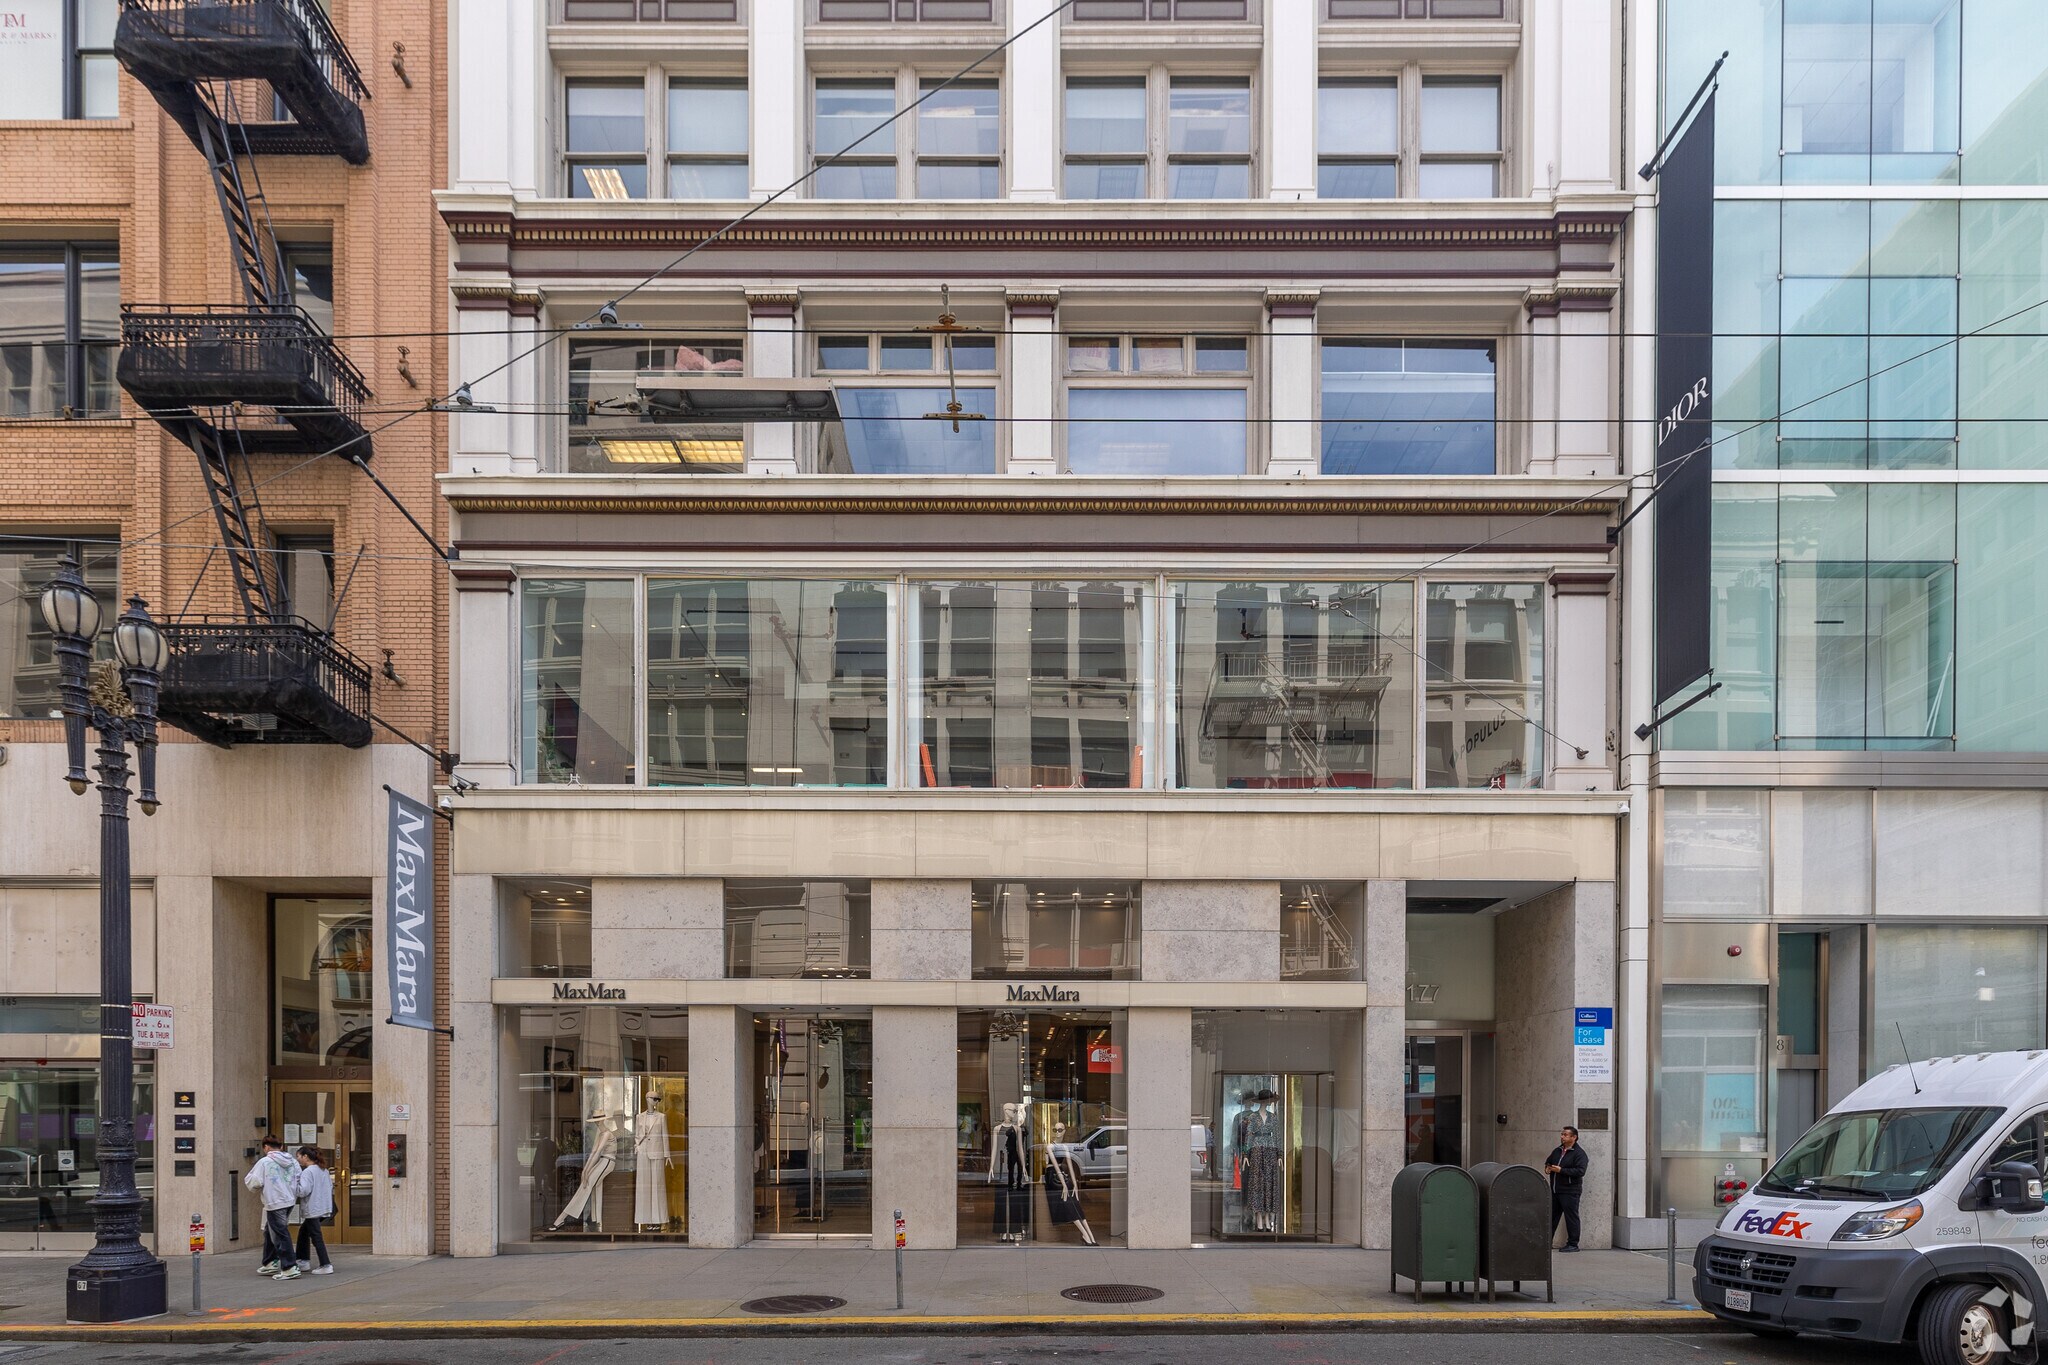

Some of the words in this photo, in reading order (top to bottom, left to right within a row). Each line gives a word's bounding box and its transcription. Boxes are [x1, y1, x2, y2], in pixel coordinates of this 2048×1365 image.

[1658, 376, 1709, 448] DIOR
[395, 801, 426, 1014] MaxMara
[552, 982, 627, 1000] MaxMara
[1006, 984, 1081, 1002] MaxMara
[1405, 984, 1440, 1001] 177
[132, 1004, 145, 1017] NO
[146, 1008, 173, 1018] PARKING
[1578, 1028, 1592, 1036] For
[1578, 1036, 1602, 1044] Lease
[1733, 1209, 1813, 1240] FedEx
[1935, 1226, 1972, 1236] 259849
[2033, 1254, 2048, 1265] 1.8
